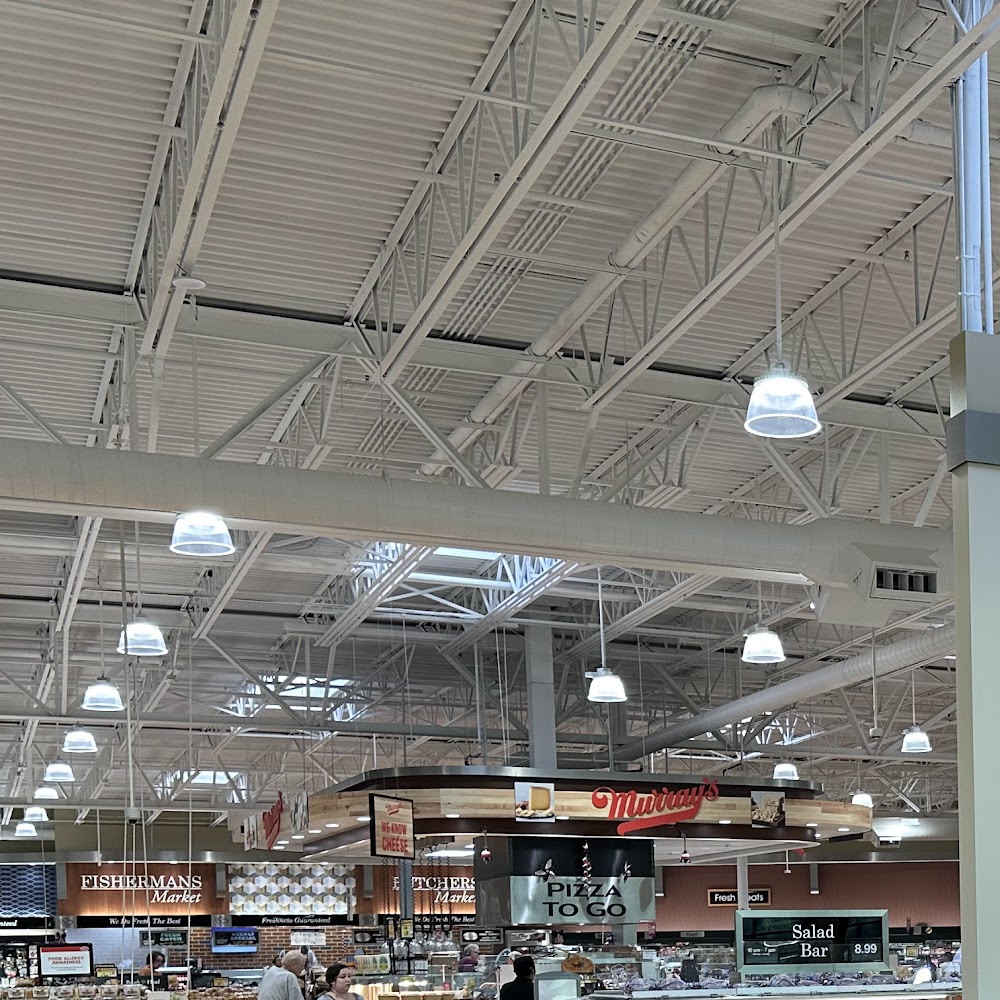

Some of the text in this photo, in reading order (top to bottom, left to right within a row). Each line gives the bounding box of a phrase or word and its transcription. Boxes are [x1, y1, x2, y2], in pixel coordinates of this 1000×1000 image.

[591, 778, 719, 835] Murray's
[381, 822, 407, 835] WE KNOW
[382, 837, 408, 853] CHEESE
[80, 875, 202, 888] FISHERMANS
[393, 876, 475, 891] BTCHERS
[150, 890, 201, 903] Market
[434, 890, 476, 903] Marke
[546, 882, 622, 898] PIZZA
[714, 893, 764, 902] Fresh eats
[542, 901, 626, 917] TO GO
[792, 924, 835, 940] Salad
[801, 943, 829, 958] Bar
[854, 944, 878, 954] 8.99
